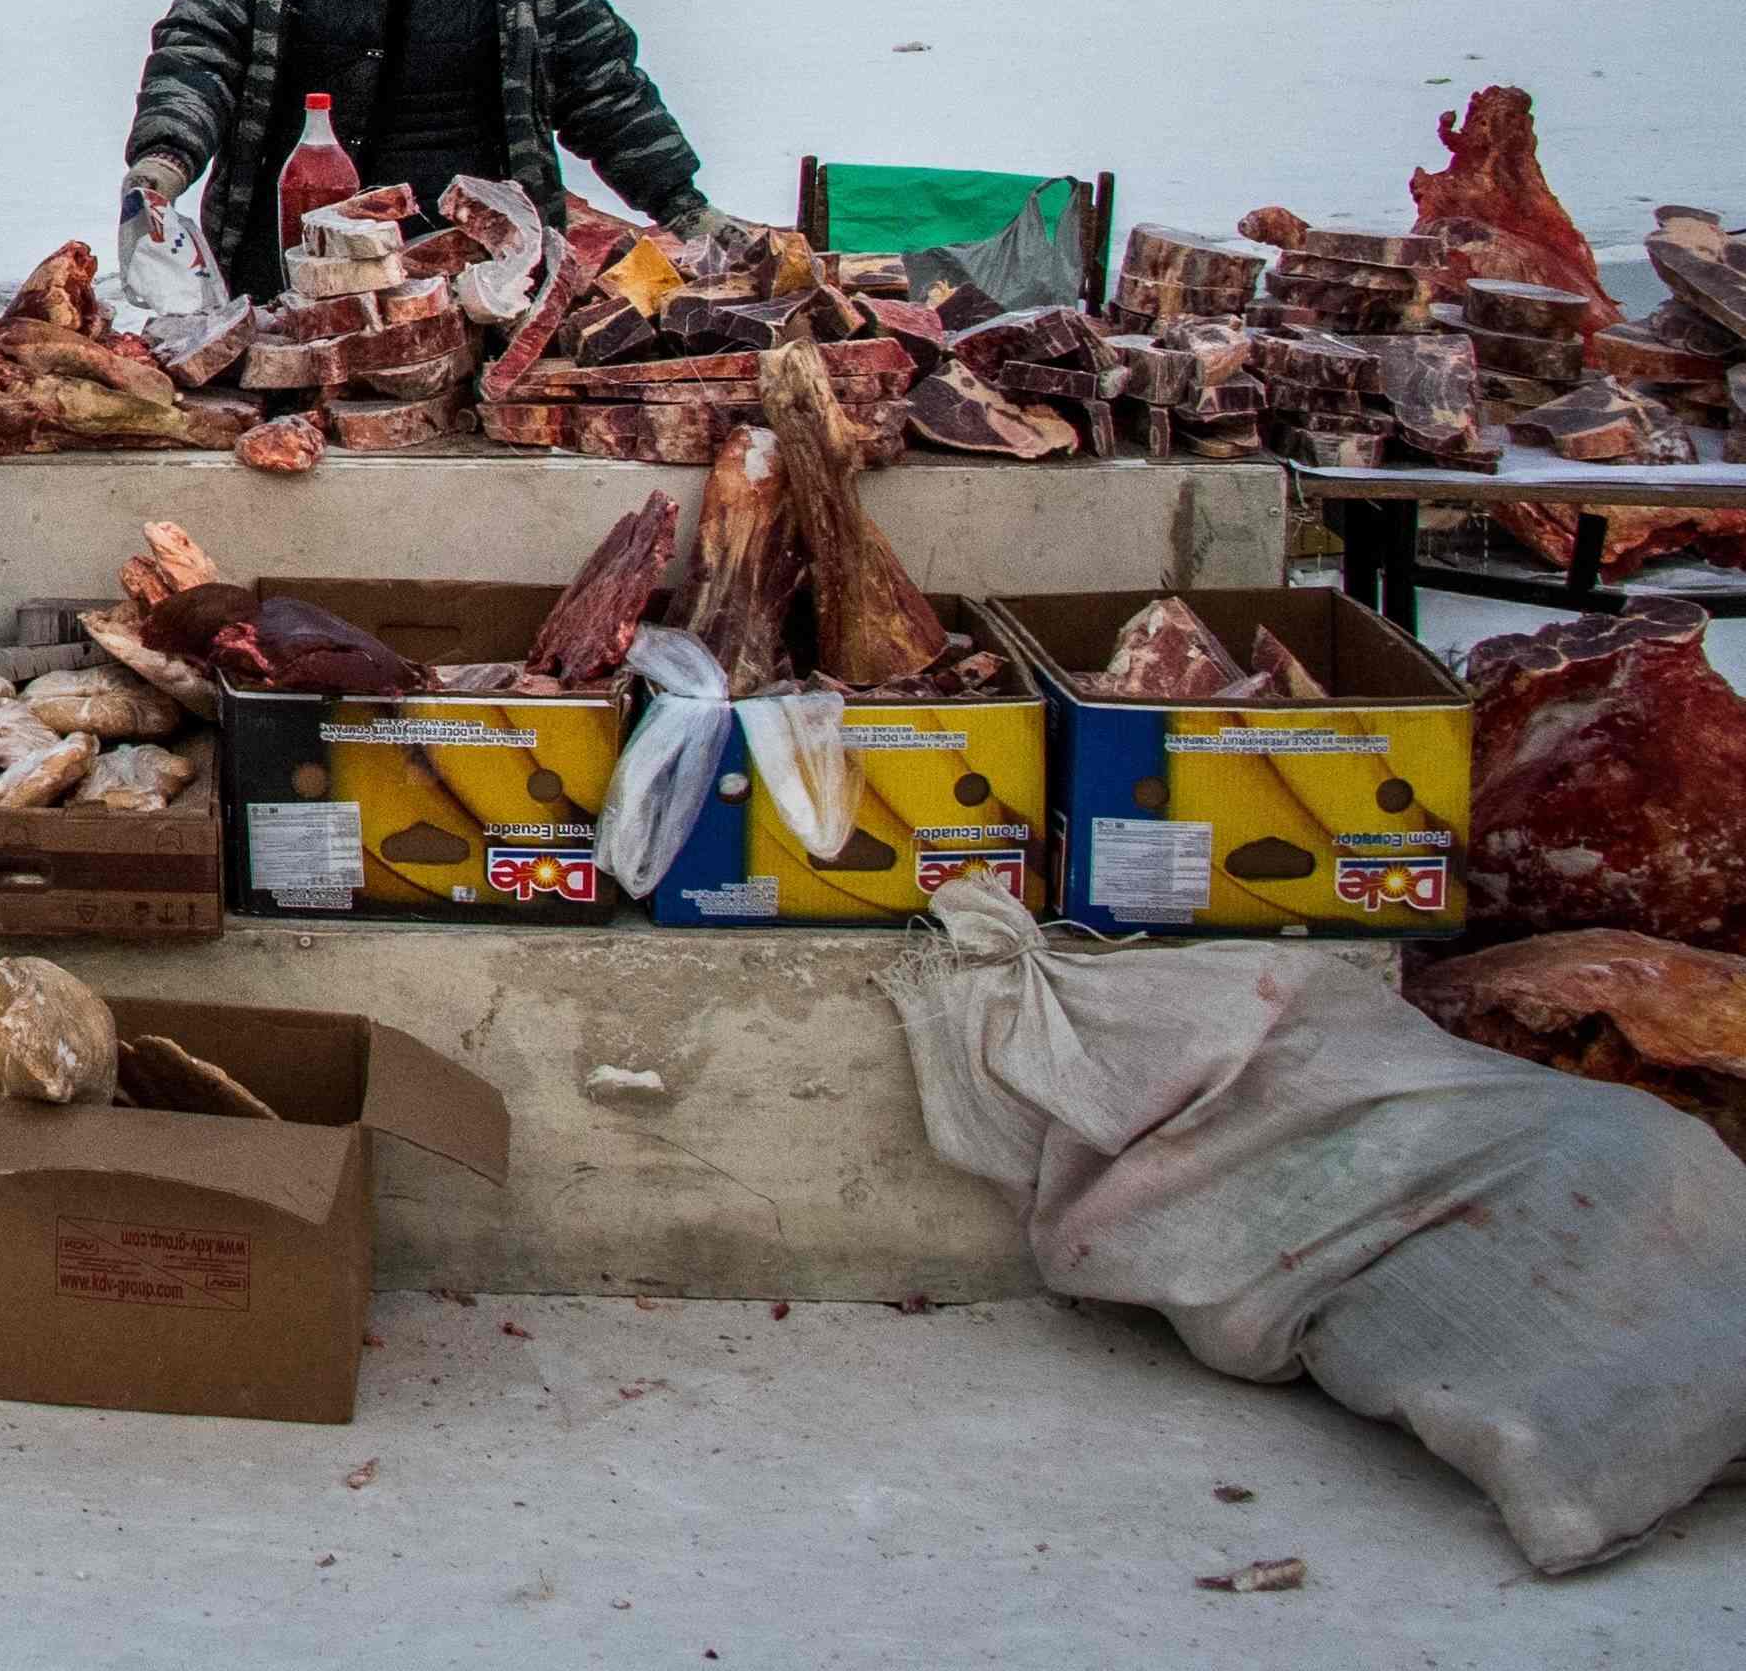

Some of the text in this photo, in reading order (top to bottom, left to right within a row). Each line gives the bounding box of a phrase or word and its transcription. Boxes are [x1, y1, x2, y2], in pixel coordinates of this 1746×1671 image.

[484, 823, 553, 839] Ecuador
[914, 824, 1028, 841] From Ecuador
[1332, 831, 1451, 847] From Ecuador
[489, 858, 595, 901] Dole
[1336, 868, 1444, 911] Dole
[59, 1272, 185, 1300] www.kdv-group.com
